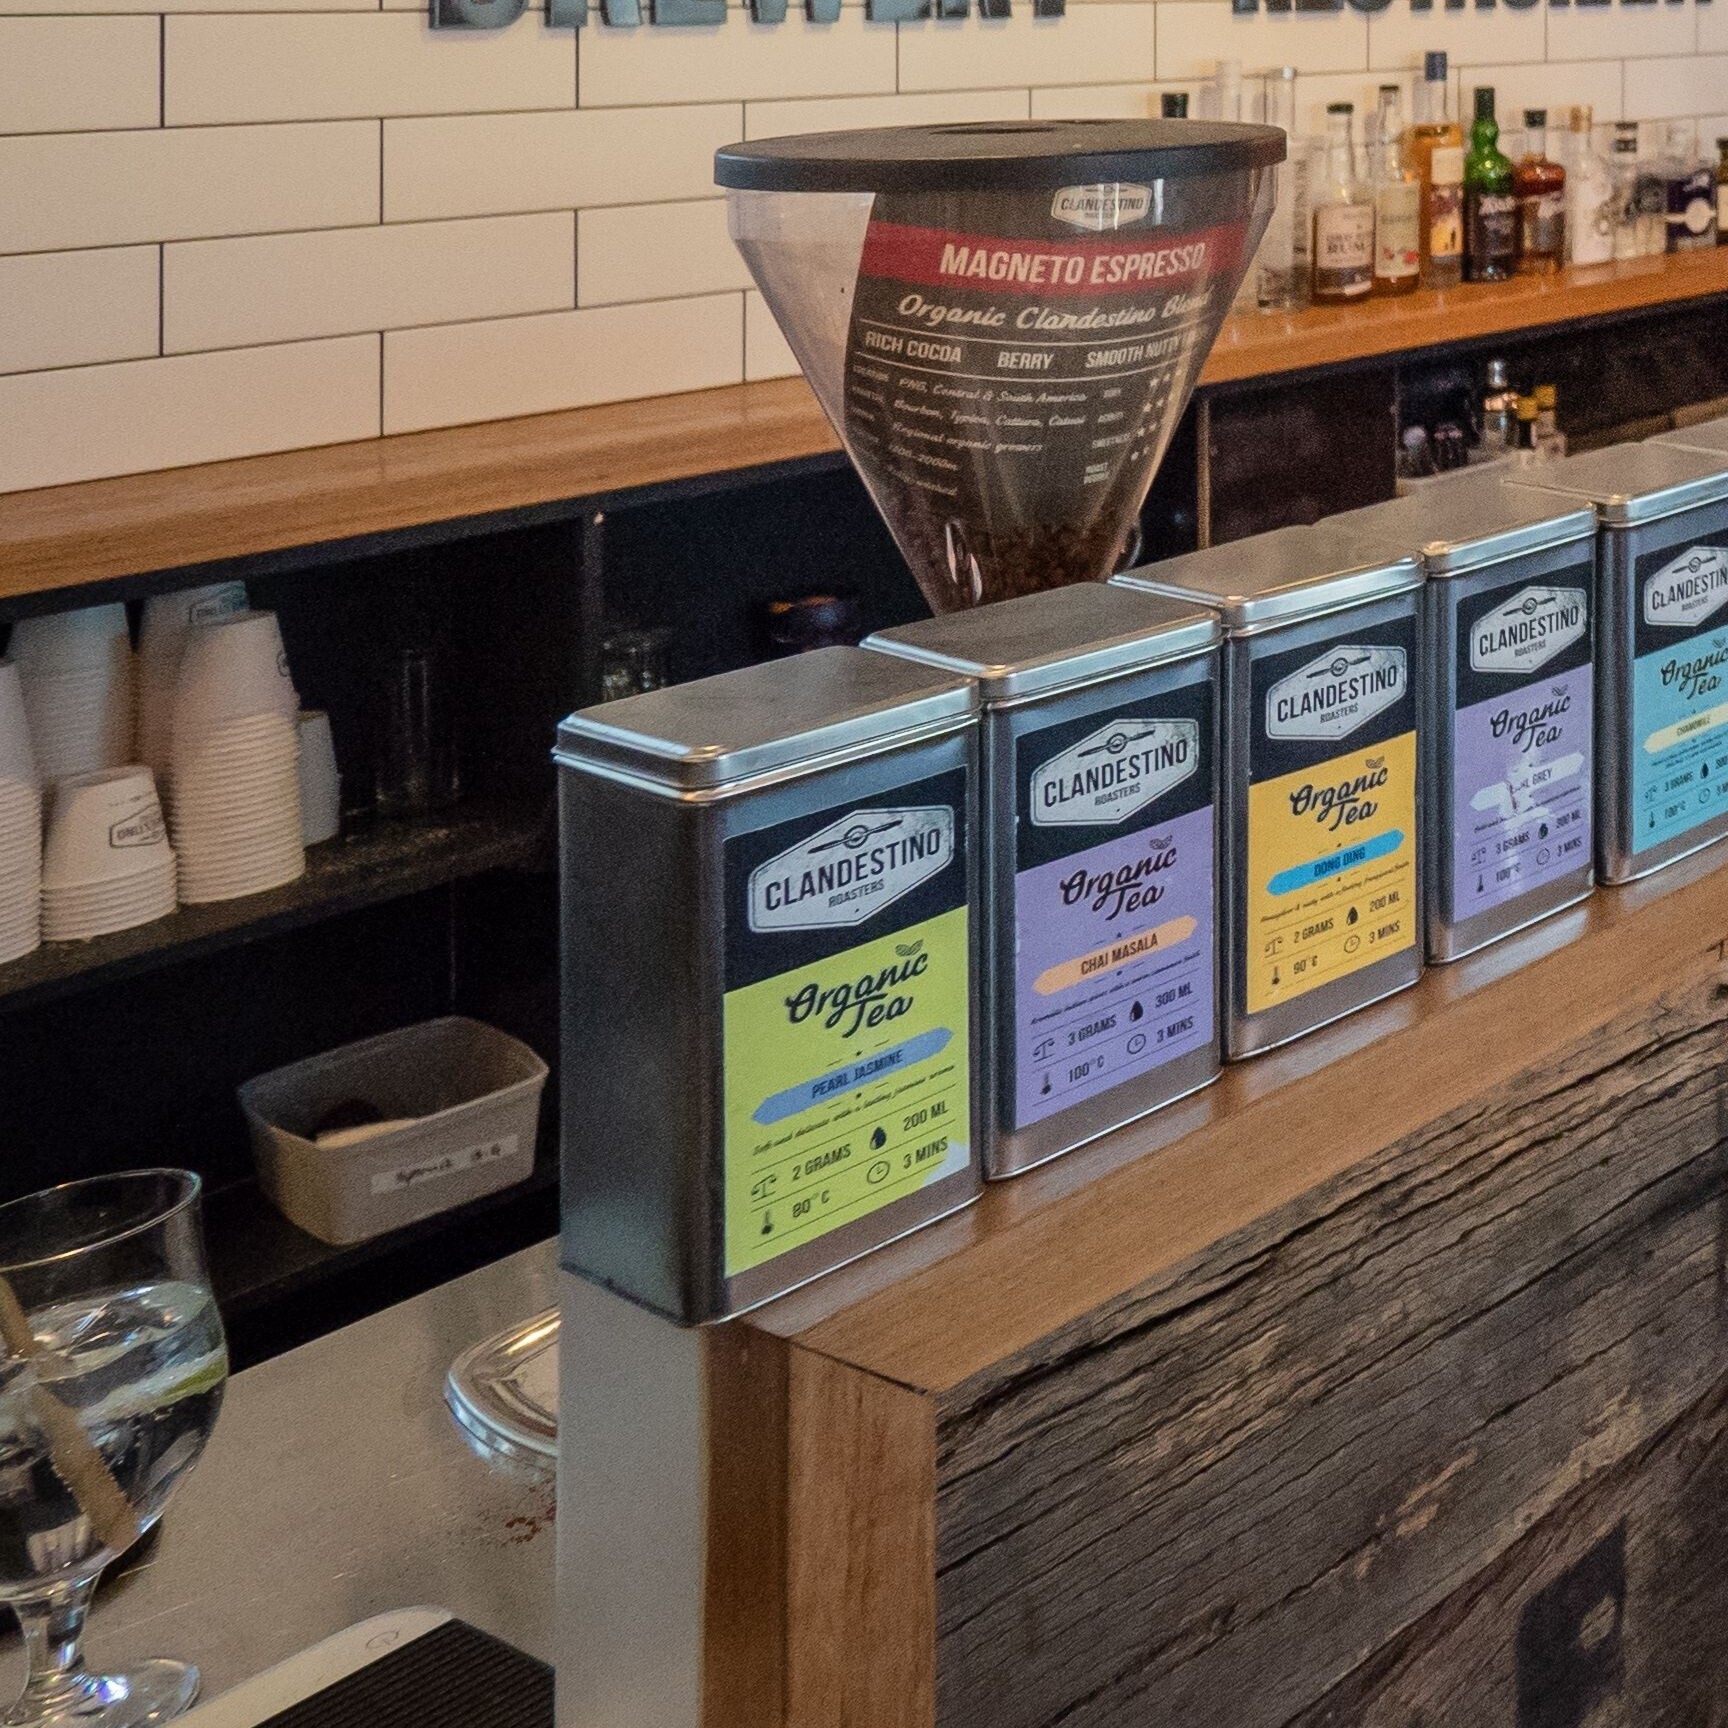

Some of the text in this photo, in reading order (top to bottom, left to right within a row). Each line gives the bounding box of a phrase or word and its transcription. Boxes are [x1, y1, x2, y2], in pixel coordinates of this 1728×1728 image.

[1060, 195, 1145, 212] CLANDESTINO
[940, 242, 1207, 284] MAGNETO ESPRESSO
[899, 293, 1005, 328] Organic
[1016, 305, 1156, 331] Clandestino
[865, 330, 962, 364] RICH COCOA
[997, 351, 1054, 369] BERRY
[1085, 345, 1143, 369] SMOOTH
[1479, 605, 1579, 657] CLANDESTINO
[1661, 647, 1728, 693] Organic
[1686, 671, 1722, 700] Tea
[1277, 665, 1398, 723] CLANDESTINO
[1320, 702, 1359, 724] ROASTERS
[1490, 695, 1571, 745] Organic
[1521, 722, 1563, 753] Tea
[1044, 738, 1188, 807] CLANDESTINO
[1094, 782, 1142, 807] ROASTERS
[1289, 767, 1388, 823] Organic
[1328, 797, 1378, 832] Tea
[765, 827, 942, 911] CLANDESTINO
[1060, 847, 1177, 912] Organic
[828, 878, 884, 908] ROASTERS
[1105, 881, 1166, 921] Tea
[1293, 917, 1334, 944] 2 GRAMS
[1368, 921, 1401, 944] 3 MINS
[1081, 932, 1159, 976] CHAI MASALA
[785, 952, 929, 1029] Organic
[1155, 981, 1194, 1009] 300 ML
[841, 993, 914, 1038] Tea
[1068, 1014, 1117, 1047] 3 GRAMS
[1156, 1015, 1195, 1044] 3 MINS
[811, 1049, 904, 1099] PEARL JASMINE
[903, 1100, 949, 1132] 200 ML
[792, 1143, 851, 1182] 2 GRAMS
[903, 1136, 949, 1170] 3 MINS
